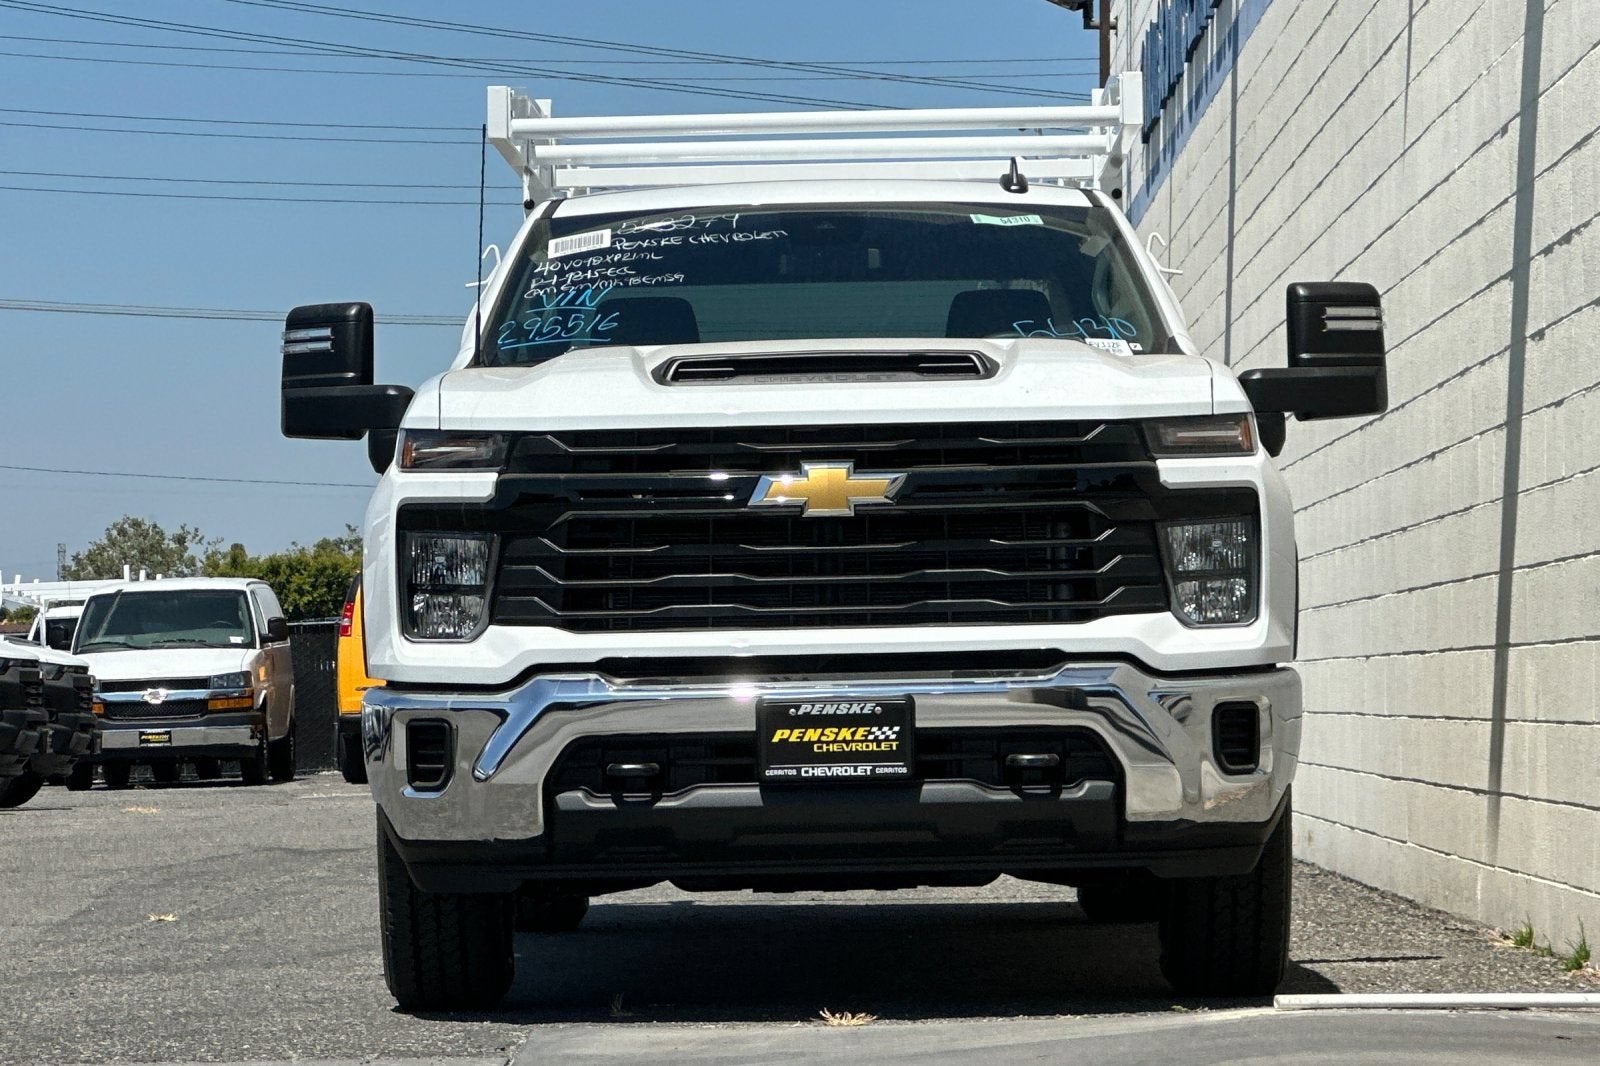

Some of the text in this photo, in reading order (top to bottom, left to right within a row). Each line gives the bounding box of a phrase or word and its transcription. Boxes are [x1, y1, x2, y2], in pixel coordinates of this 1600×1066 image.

[611, 235, 685, 251] PENSKE
[542, 285, 615, 308] VIN
[497, 312, 620, 345] 295516
[754, 374, 897, 383] CHEVROLET
[797, 703, 876, 715] PENSKE
[771, 726, 871, 742] PENSKE
[813, 741, 899, 752] CHEVROLET
[801, 766, 872, 777] CHEVROLET
[875, 766, 908, 774] CERRITOS
